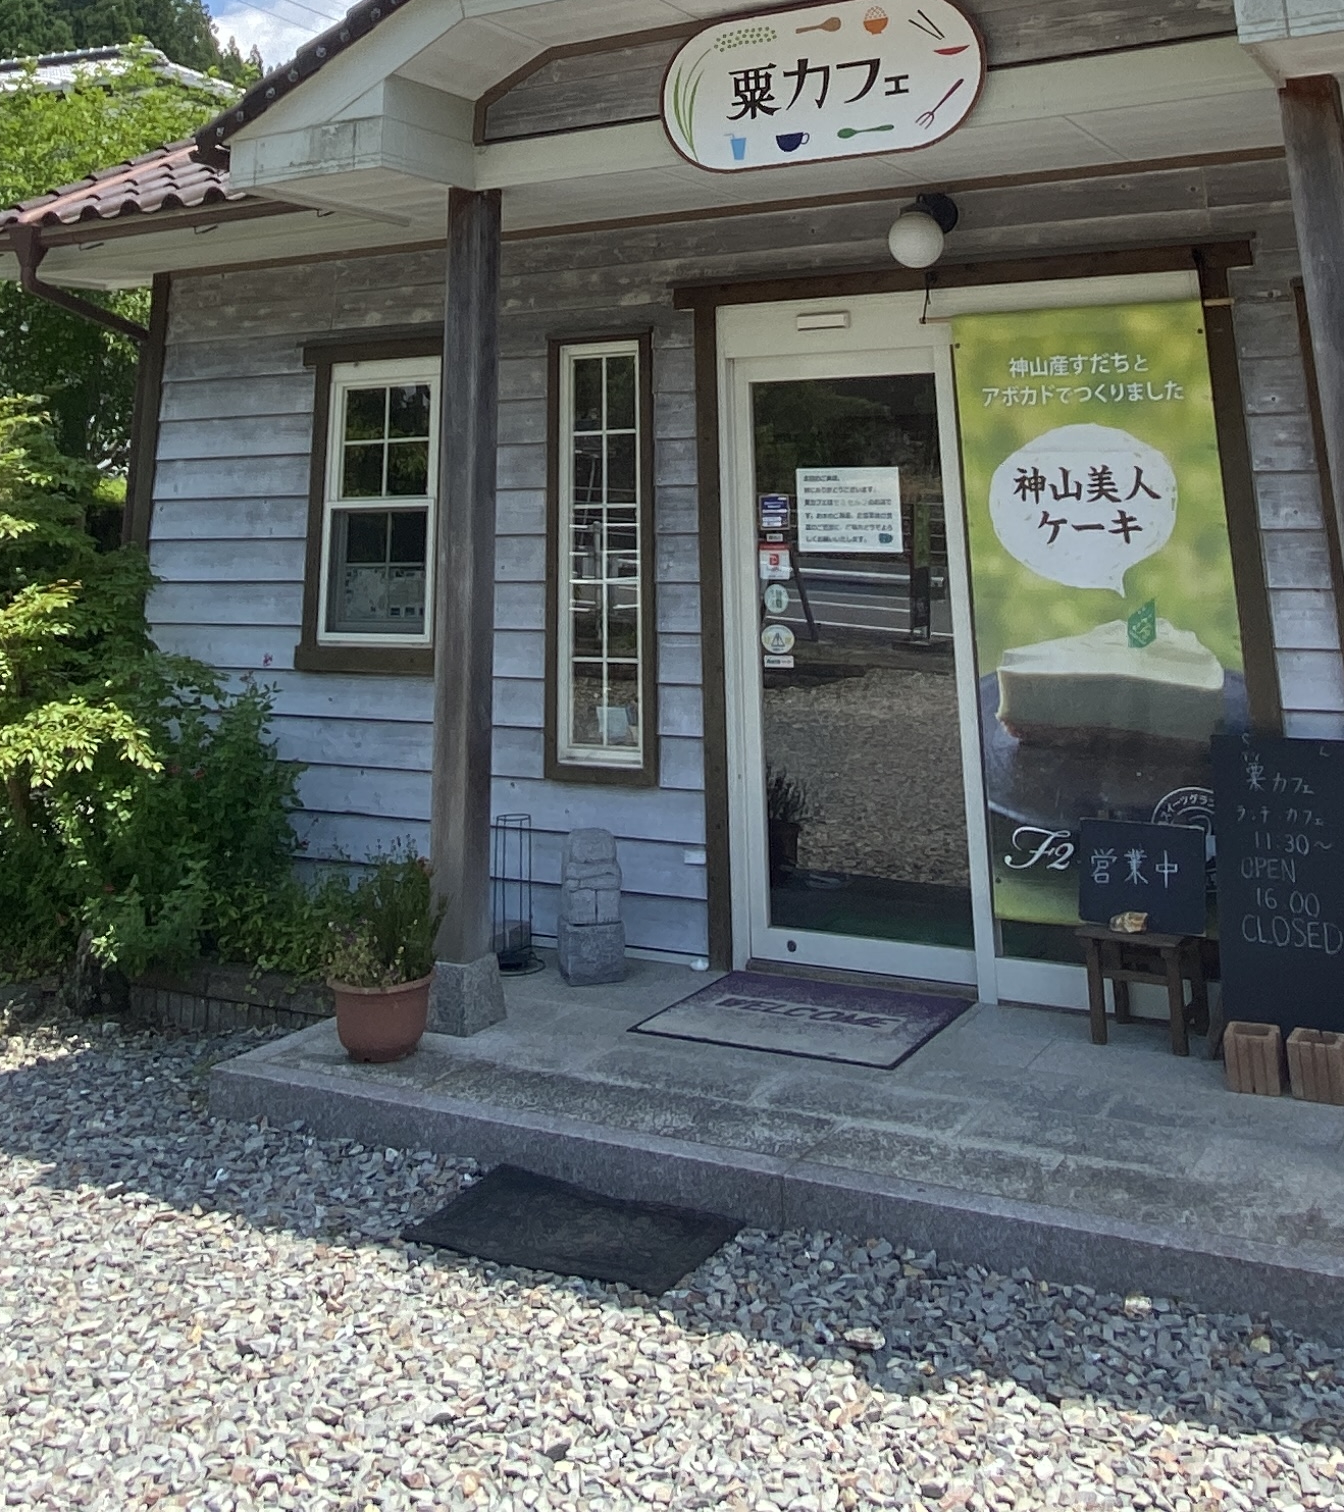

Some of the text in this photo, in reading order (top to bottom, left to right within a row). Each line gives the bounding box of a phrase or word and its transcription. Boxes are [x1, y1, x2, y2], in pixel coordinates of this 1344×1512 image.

[726, 58, 910, 120] 粟カフェ
[1008, 351, 1150, 378] 神山産すだちと
[981, 379, 1185, 407] アボカドでつくりました
[1012, 464, 1162, 505] 神山美人
[1038, 509, 1143, 545] ケーキ
[1090, 846, 1179, 889] 営業中
[1241, 856, 1296, 883] OPEN
[1241, 913, 1344, 955] CLOSED
[715, 997, 902, 1029] WELCOME
